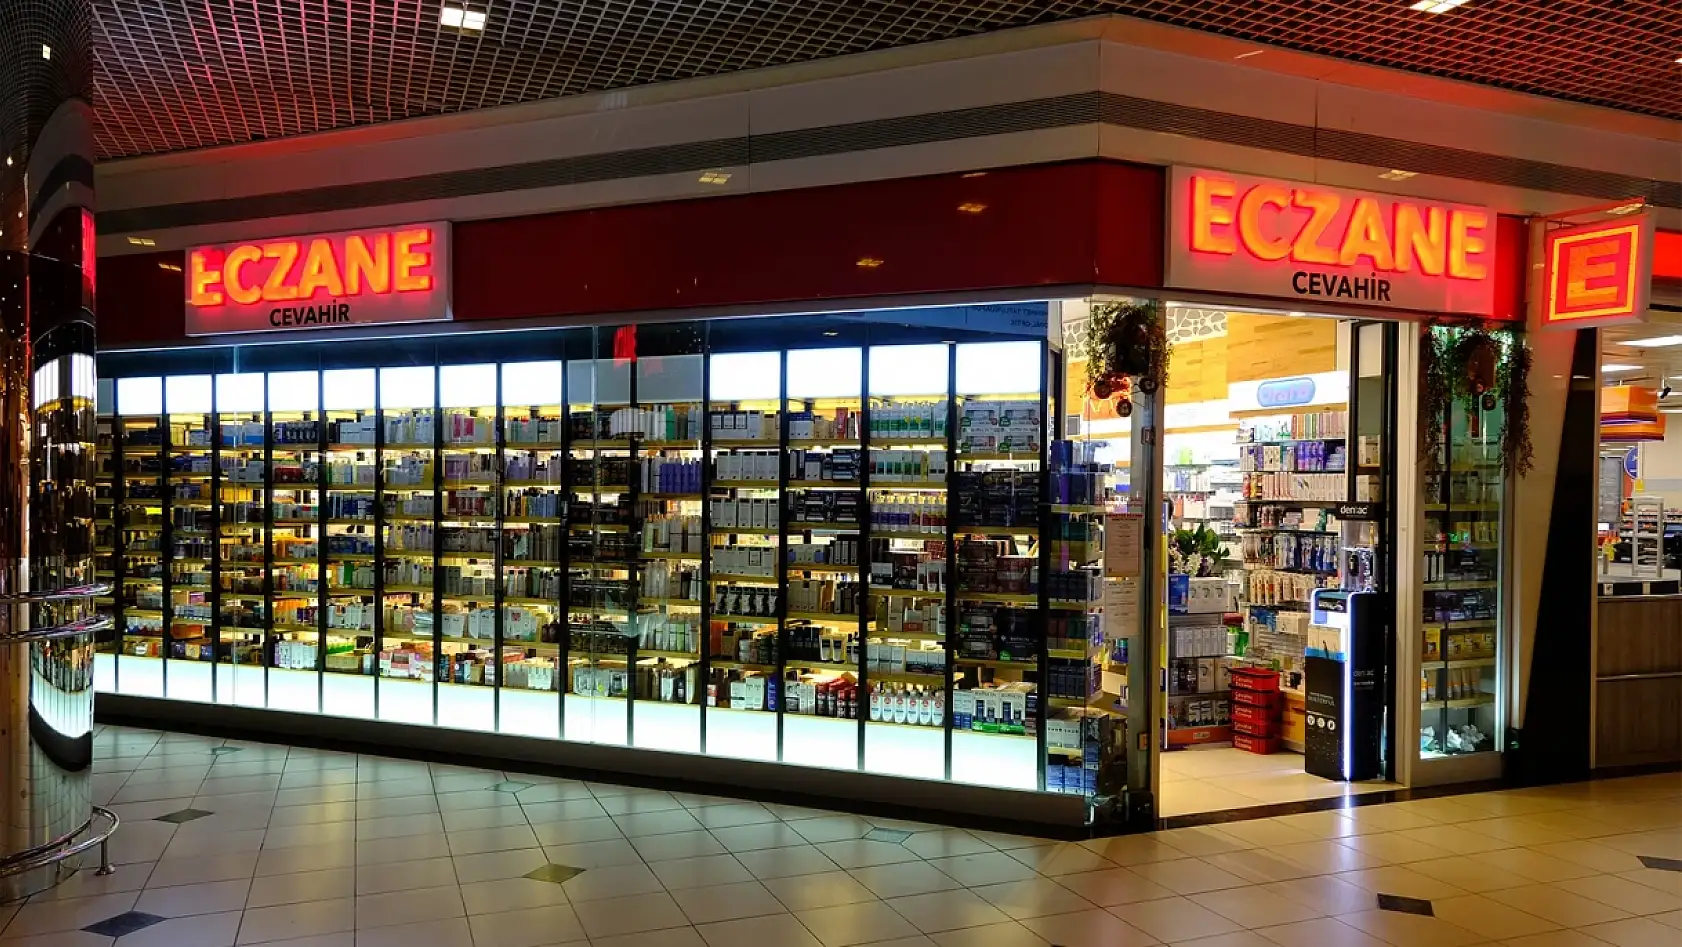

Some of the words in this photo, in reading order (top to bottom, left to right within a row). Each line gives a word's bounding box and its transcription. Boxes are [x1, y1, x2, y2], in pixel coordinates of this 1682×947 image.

[1189, 175, 1488, 280] ECZANE
[190, 227, 432, 306] ECZANE
[1292, 271, 1391, 302] CEVAHİR
[1566, 240, 1620, 308] E
[270, 299, 350, 327] CEVAHİR
